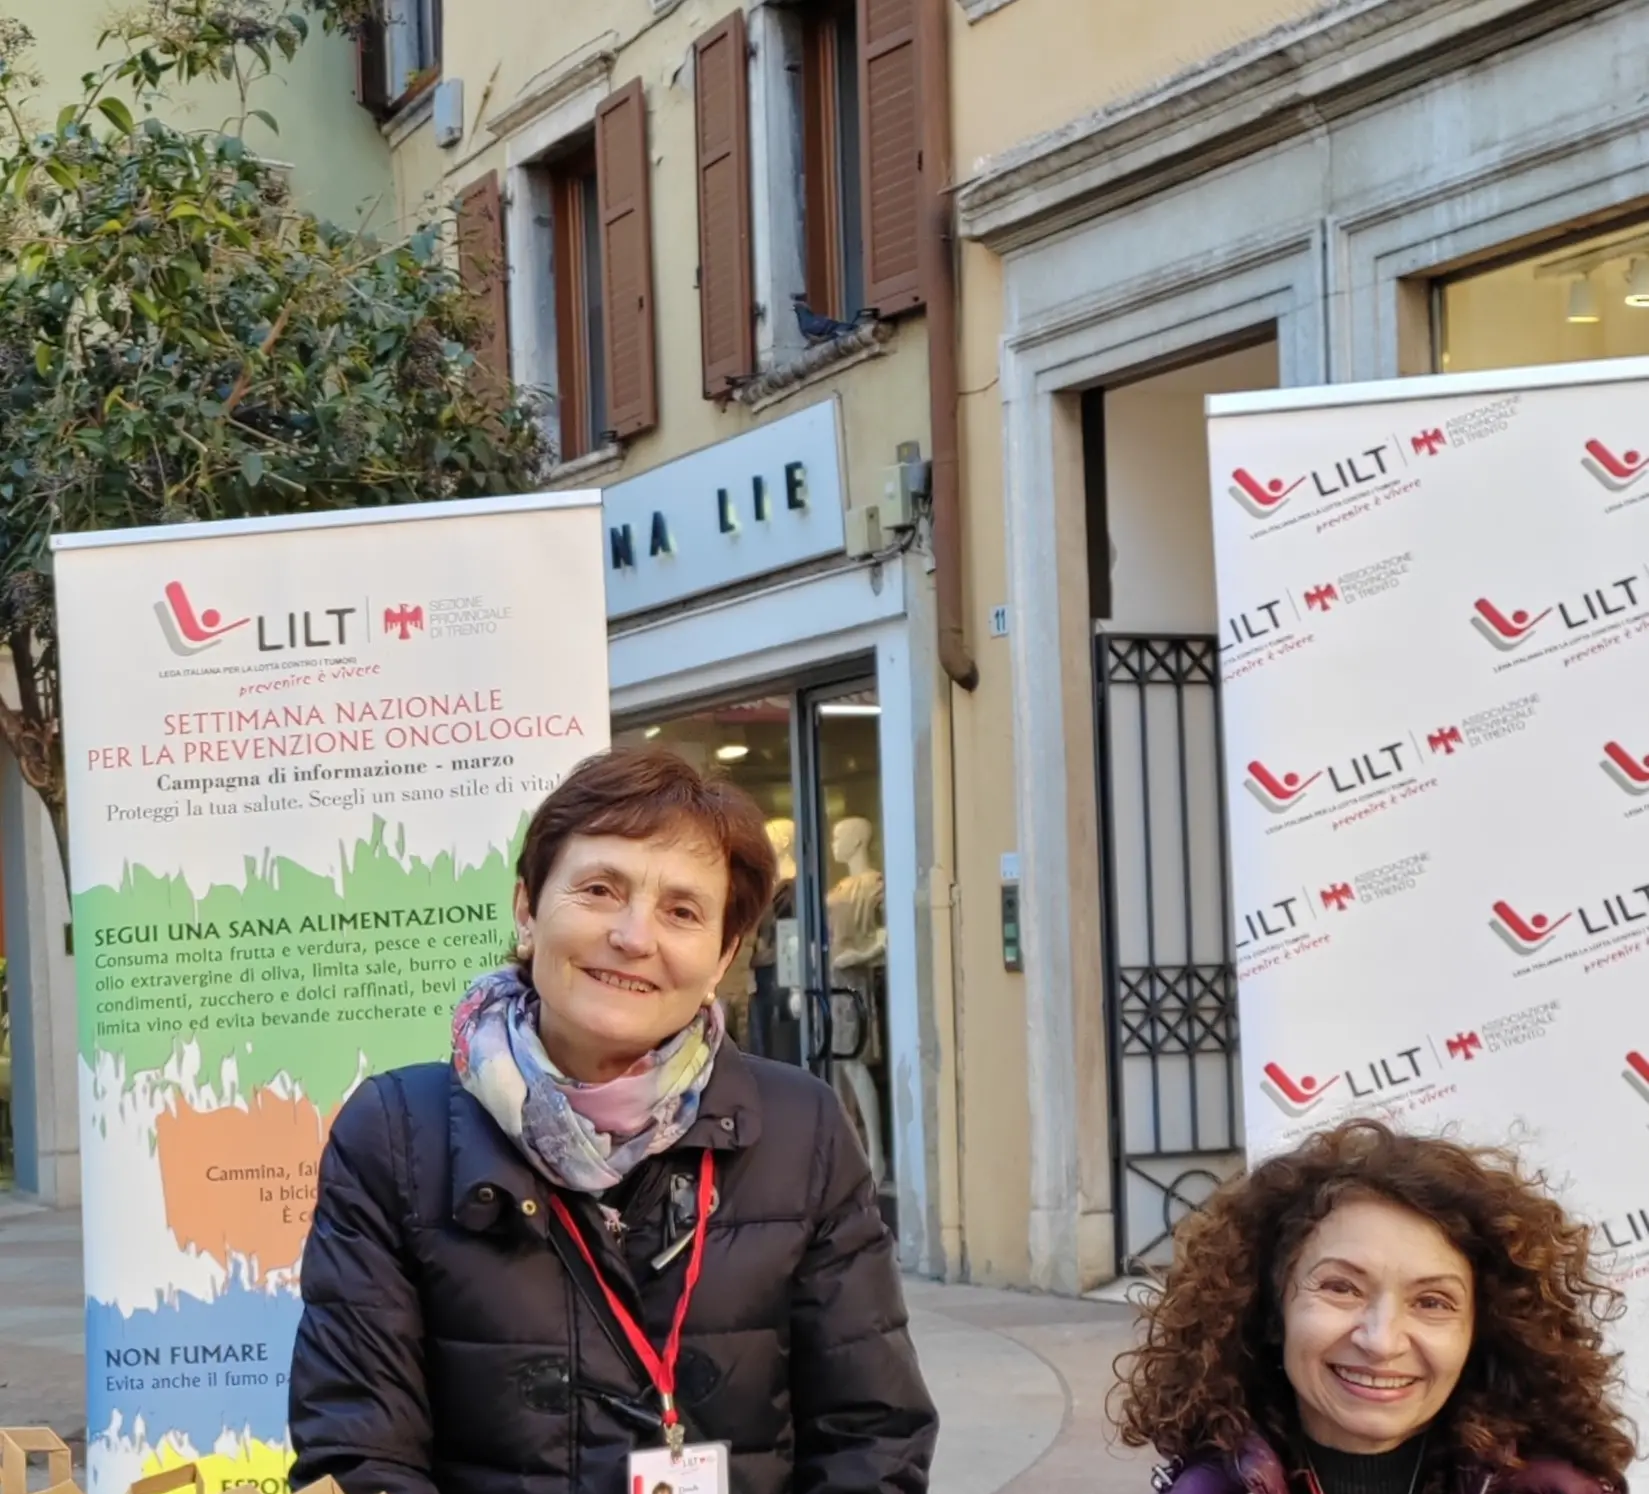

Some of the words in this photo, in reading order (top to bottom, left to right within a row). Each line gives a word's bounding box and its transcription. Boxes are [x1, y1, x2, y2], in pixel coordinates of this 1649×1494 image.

[1312, 445, 1387, 497] LILT
[1316, 501, 1370, 533] prevenire
[1385, 478, 1421, 500] vivere
[995, 608, 1007, 630] 11
[1558, 576, 1638, 629] LILT
[257, 607, 356, 651] LILT
[239, 674, 311, 698] prevenire
[318, 671, 326, 683] è
[331, 663, 381, 680] vivere
[164, 704, 325, 736] SETTIMANA
[336, 689, 504, 724] NAZIONALE
[88, 746, 132, 771] PER
[141, 745, 175, 766] LA
[184, 729, 375, 763] PREVENZIONE
[386, 715, 584, 749] ONCOLOGICA
[157, 772, 260, 794] Campagna
[268, 767, 286, 784] di
[294, 760, 427, 784] informazione
[452, 755, 514, 772] marzo
[1327, 742, 1404, 794] LILT
[107, 802, 180, 823] Proteggi
[186, 799, 204, 817] la
[209, 800, 238, 816] tua
[243, 794, 303, 814] salute.
[309, 787, 365, 811] Scegli
[372, 790, 395, 805] un
[401, 787, 444, 802] sano
[449, 779, 489, 799] stile
[496, 777, 514, 793] di
[94, 924, 158, 947] SEGUI
[168, 922, 221, 940] UNA
[229, 917, 292, 938] SANA
[299, 903, 498, 933] ALIMENTAZIONE
[95, 952, 168, 969] Consuma
[176, 947, 223, 964] molta
[230, 946, 276, 961] frutta
[281, 946, 291, 957] e
[297, 939, 367, 956] verdura,
[375, 936, 420, 955] pesce
[427, 937, 437, 948] e
[443, 929, 504, 948] cereali,
[96, 976, 124, 992] olio
[131, 971, 233, 989] extravergine
[240, 967, 255, 983] di
[261, 966, 305, 982] oliva,
[312, 962, 359, 978] limita
[366, 959, 402, 976] sale,
[410, 957, 457, 972] burro
[463, 956, 473, 968] e
[96, 994, 192, 1014] condimenti,
[200, 991, 274, 1008] zucchero
[280, 991, 290, 1002] e
[296, 986, 336, 1002] dolci
[344, 980, 415, 999] raffinati,
[422, 978, 457, 993] bevi
[97, 1020, 140, 1037] limita
[147, 1017, 183, 1032] vino
[189, 1015, 209, 1030] ed
[216, 1013, 255, 1028] evita
[262, 1008, 330, 1027] bevande
[337, 1003, 426, 1021] zuccherate
[434, 1004, 443, 1016] e
[1345, 1047, 1422, 1099] LILT
[206, 1164, 291, 1181] Cammina,
[260, 1187, 273, 1202] la
[105, 1348, 160, 1369] NON
[170, 1342, 268, 1364] FUMARE
[106, 1375, 144, 1392] Evita
[151, 1372, 201, 1389] anche
[208, 1371, 218, 1388] il
[224, 1370, 268, 1387] fumo
